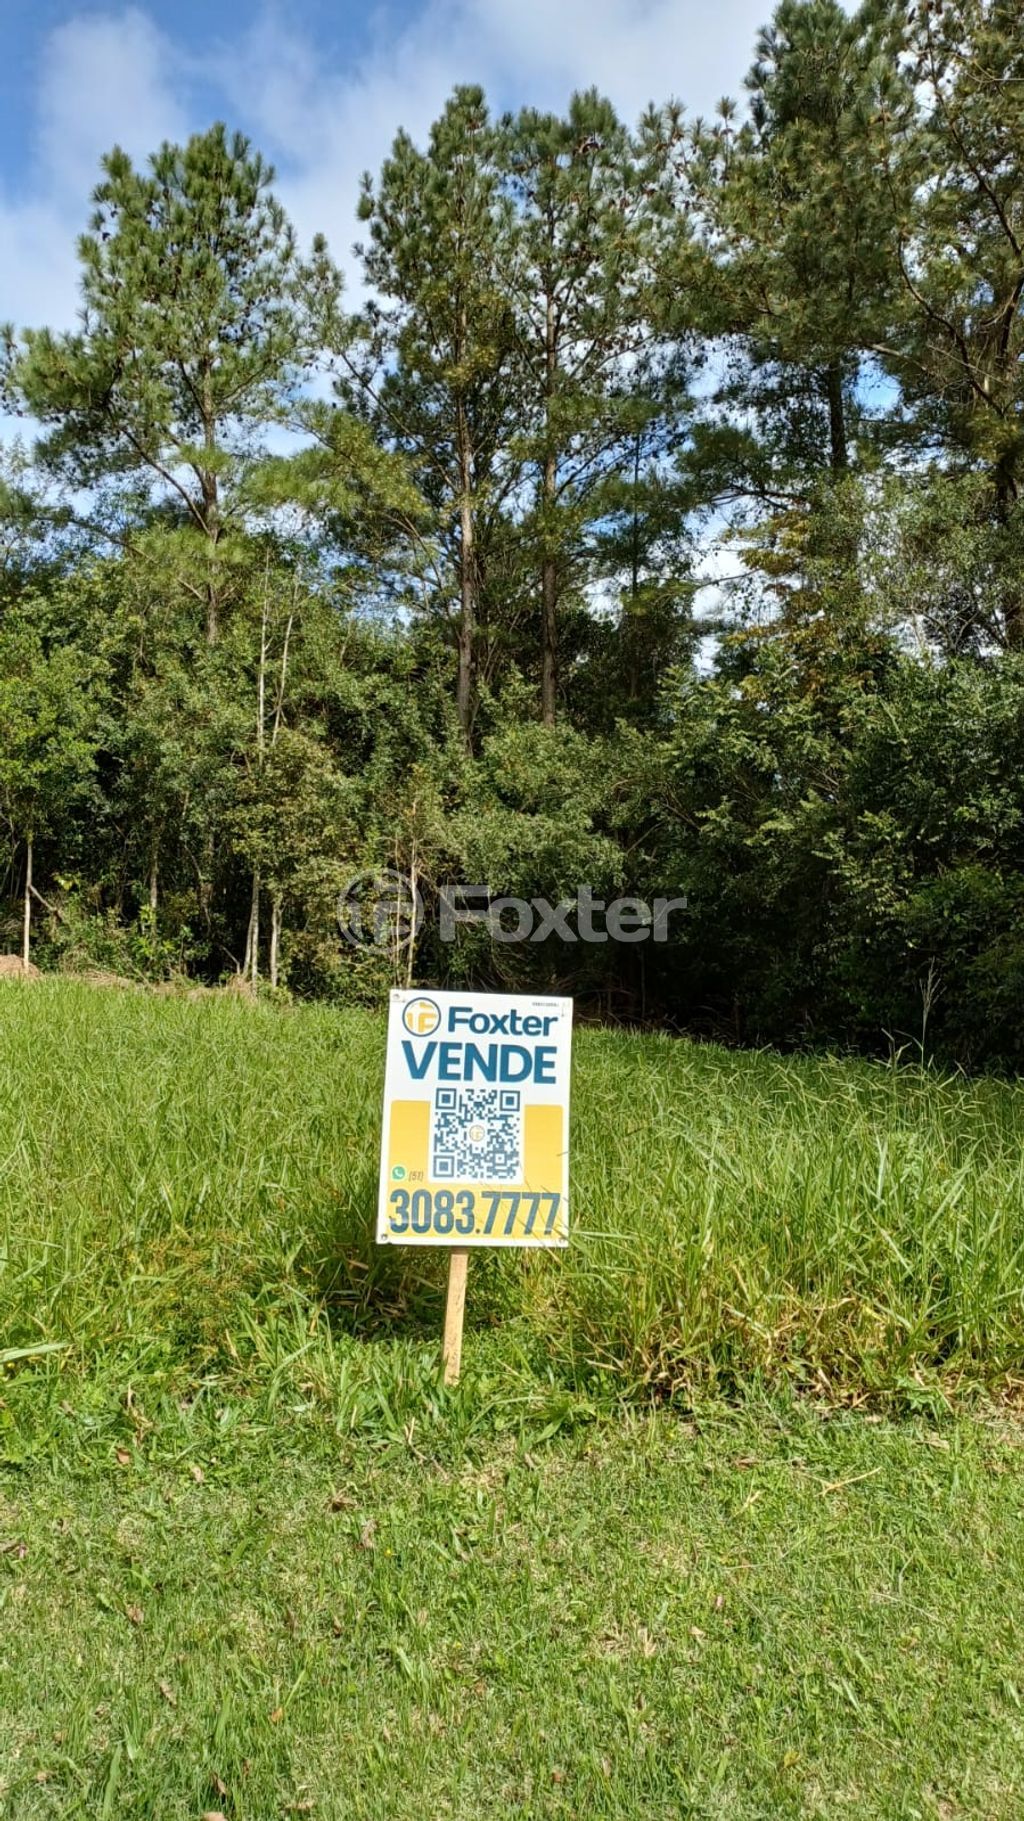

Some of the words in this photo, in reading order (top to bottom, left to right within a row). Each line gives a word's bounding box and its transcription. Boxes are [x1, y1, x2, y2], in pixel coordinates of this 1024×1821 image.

[448, 1006, 558, 1036] Foxter
[401, 1040, 557, 1084] VENDE
[408, 1171, 424, 1182] (51)
[389, 1189, 561, 1235] 3083.7777
